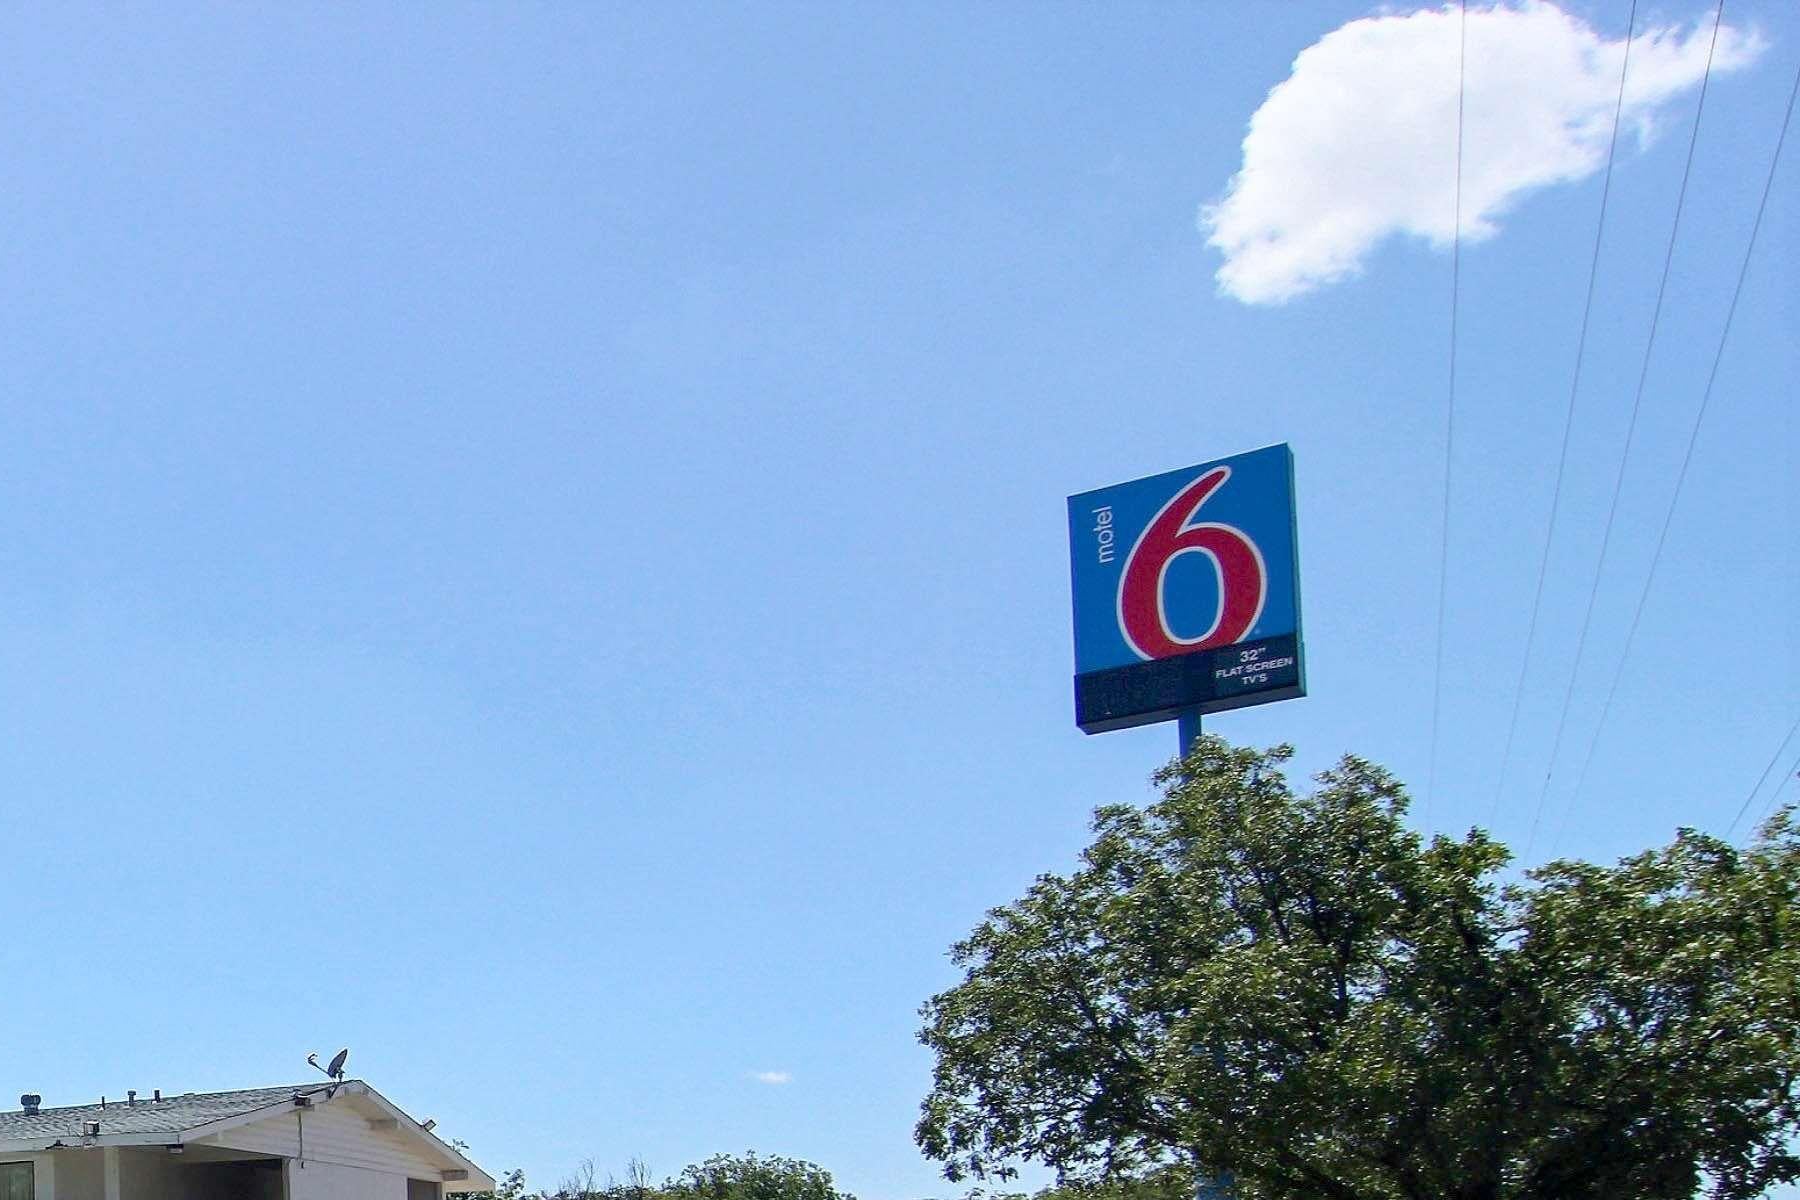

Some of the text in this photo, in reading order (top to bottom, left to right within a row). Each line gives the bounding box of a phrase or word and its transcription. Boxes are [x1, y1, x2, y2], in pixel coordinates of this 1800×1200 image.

[1092, 505, 1114, 563] motel
[1116, 465, 1267, 660] 6
[1215, 656, 1293, 679] FLAT SCREEN
